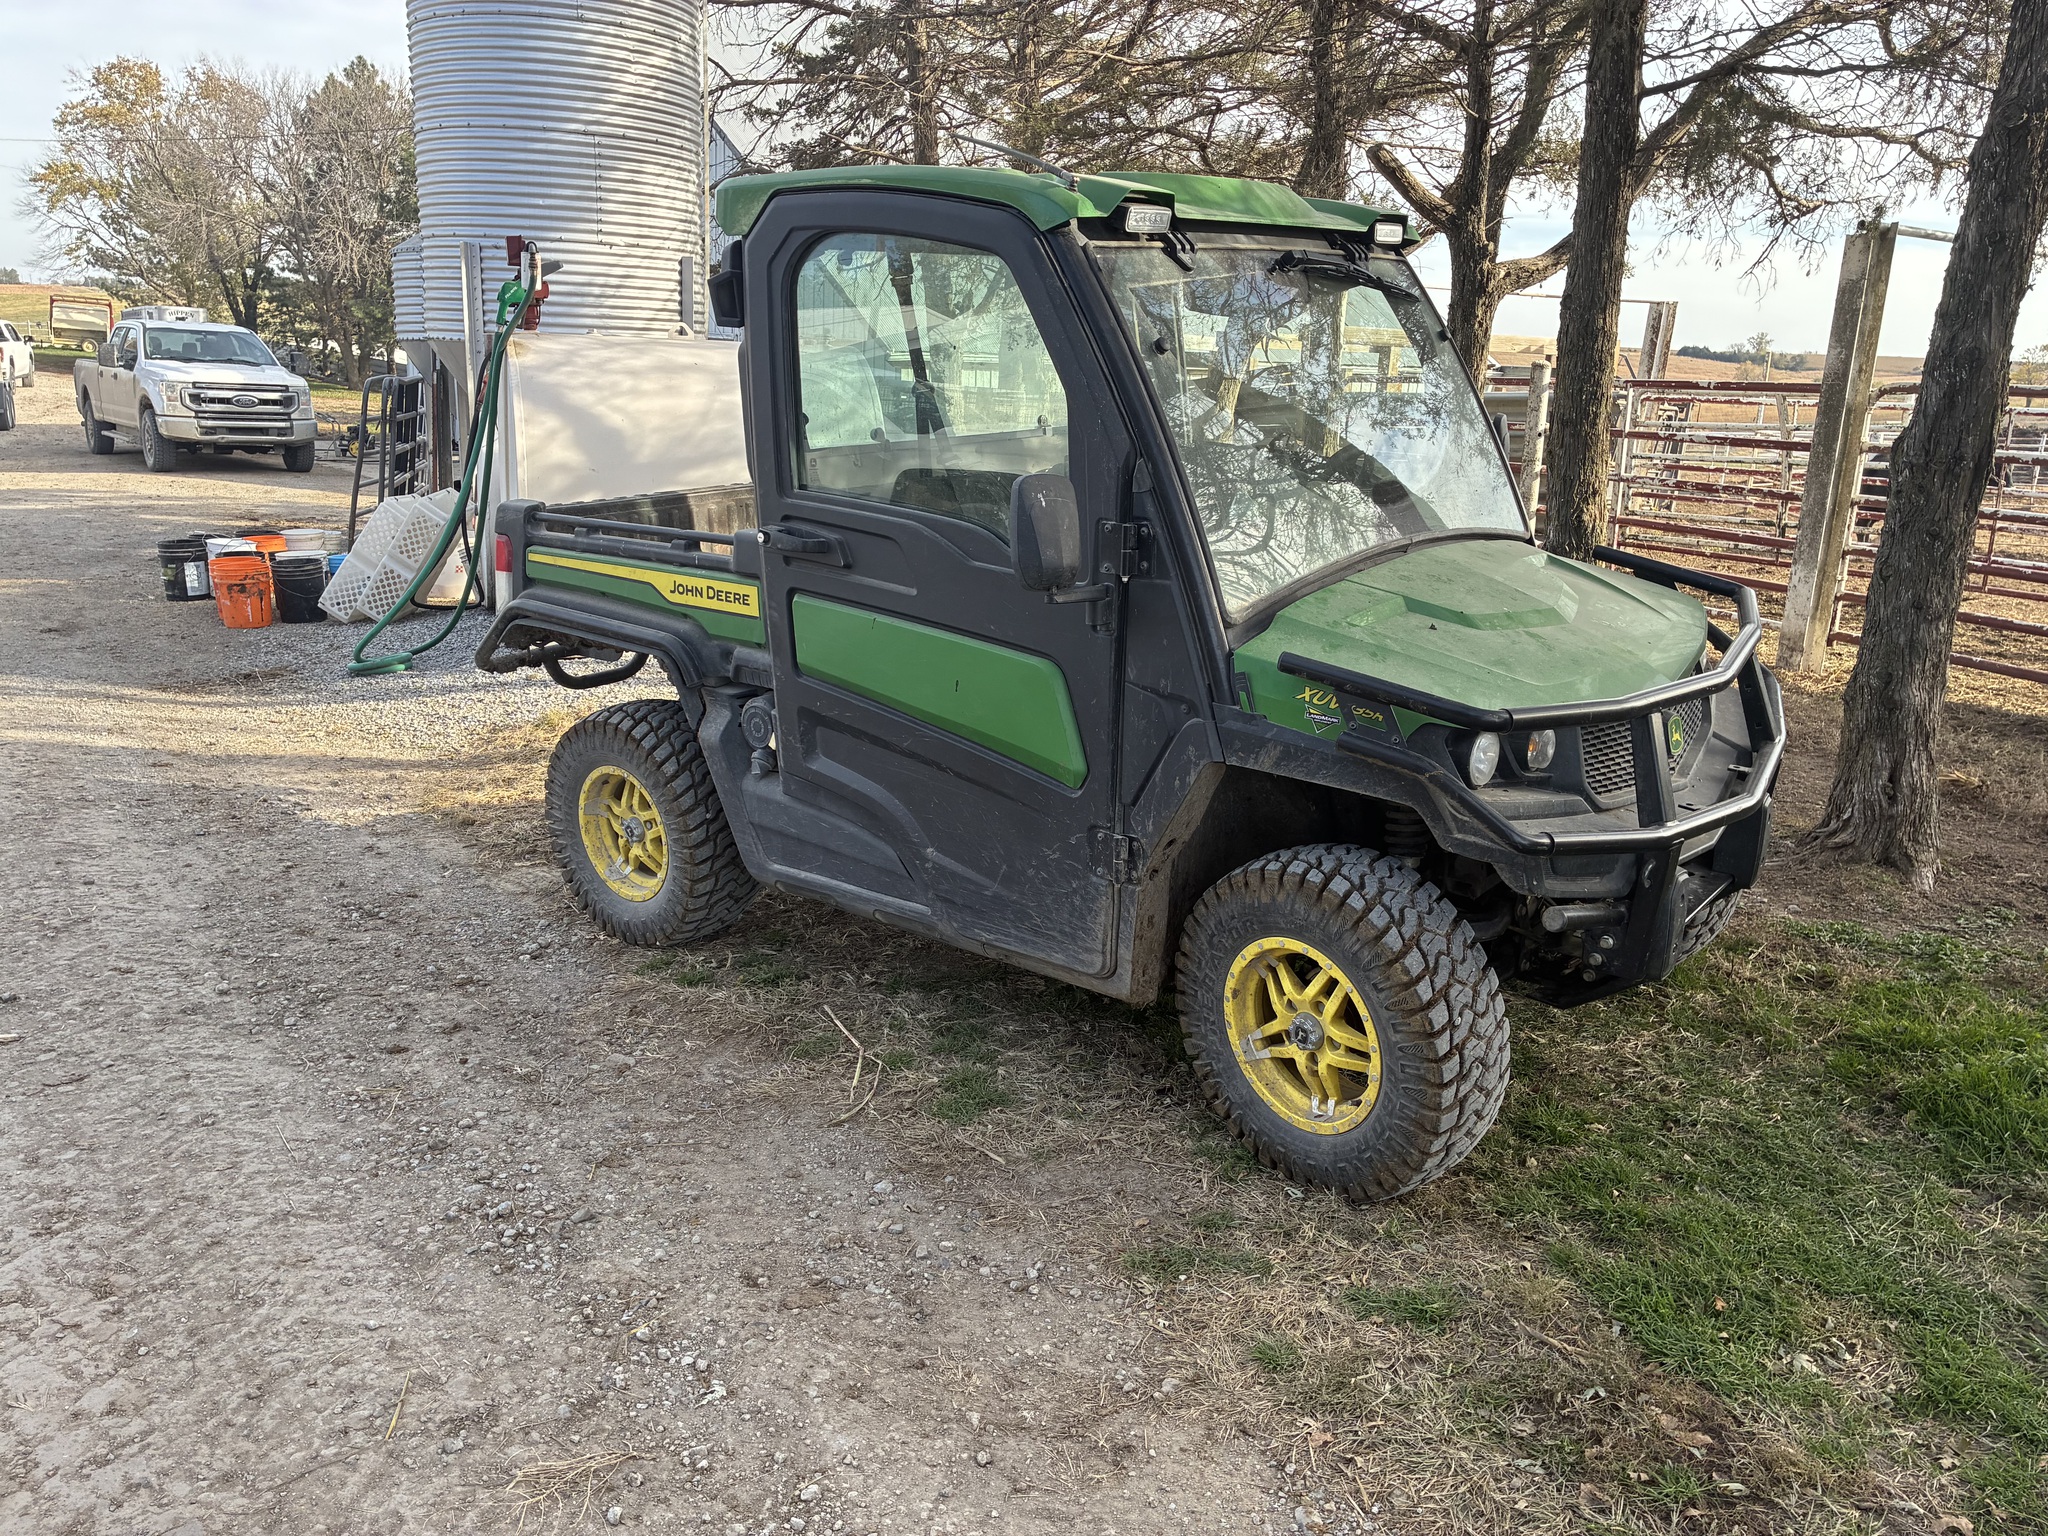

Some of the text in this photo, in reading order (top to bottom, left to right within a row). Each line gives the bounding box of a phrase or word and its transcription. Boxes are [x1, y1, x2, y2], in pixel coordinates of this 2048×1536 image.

[168, 310, 195, 318] HIPPEN
[669, 580, 750, 607] JOHN DEERE
[1295, 686, 1339, 710] XUV
